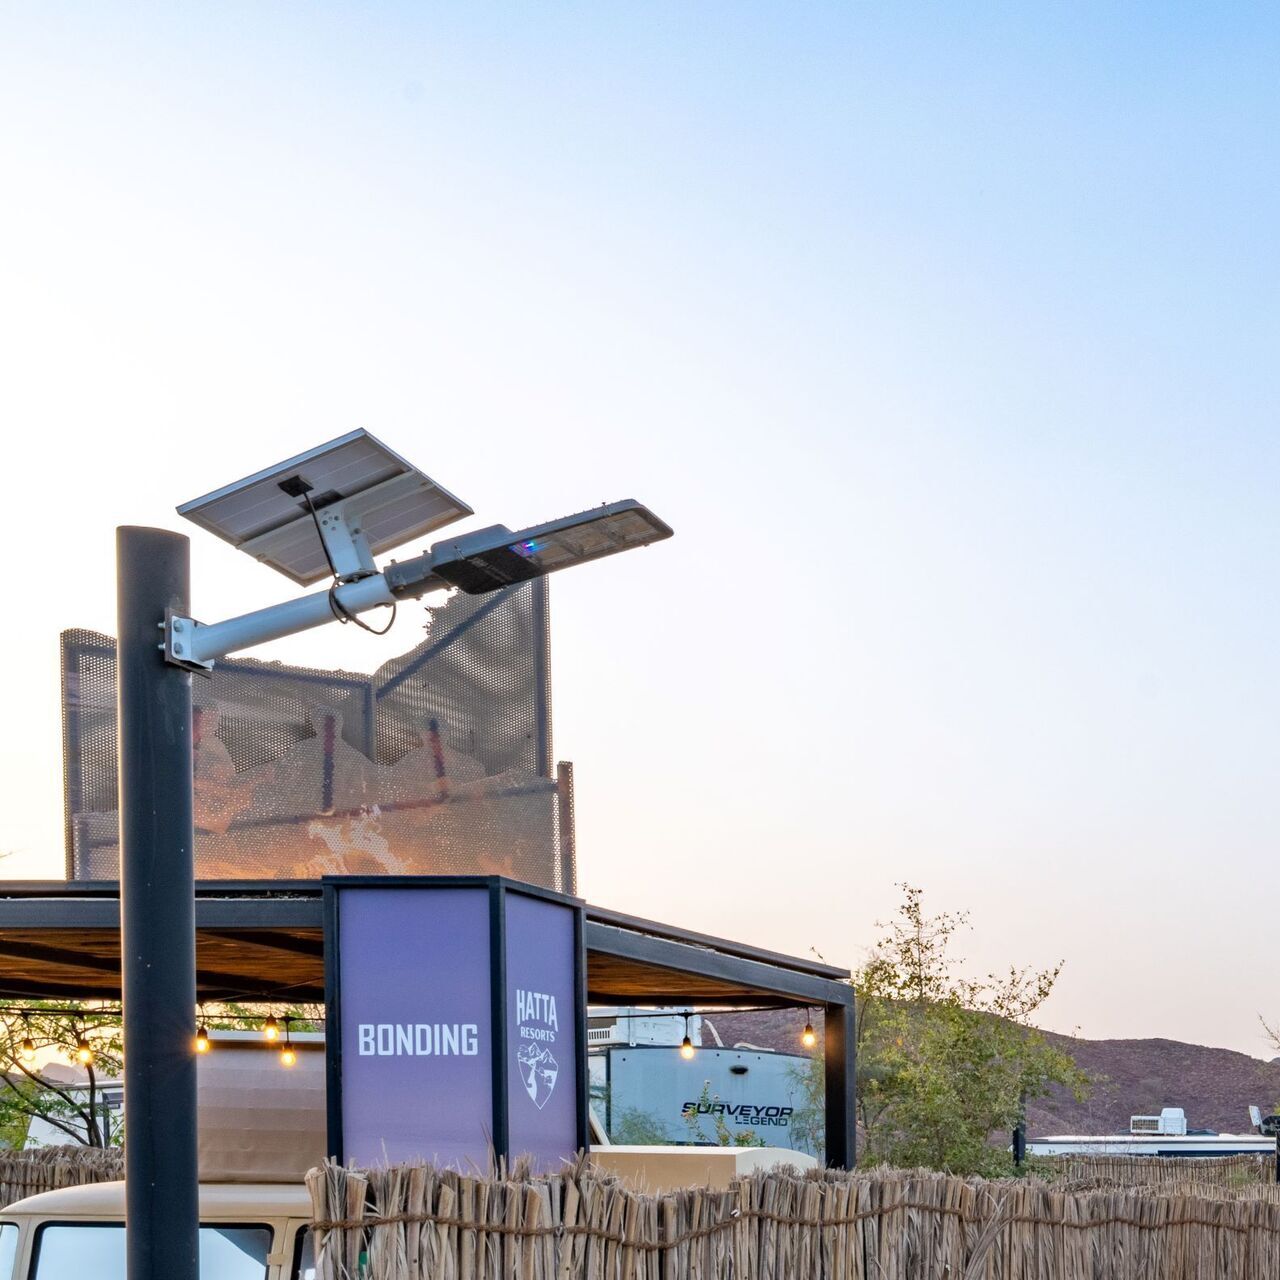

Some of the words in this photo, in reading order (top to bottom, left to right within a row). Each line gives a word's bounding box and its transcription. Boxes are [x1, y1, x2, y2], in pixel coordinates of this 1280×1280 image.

[516, 989, 559, 1032] HATTA
[358, 1023, 479, 1056] BONDING
[520, 1026, 556, 1042] RESORTS
[681, 1102, 794, 1117] SURVEYOR
[735, 1115, 788, 1127] LEGEND
